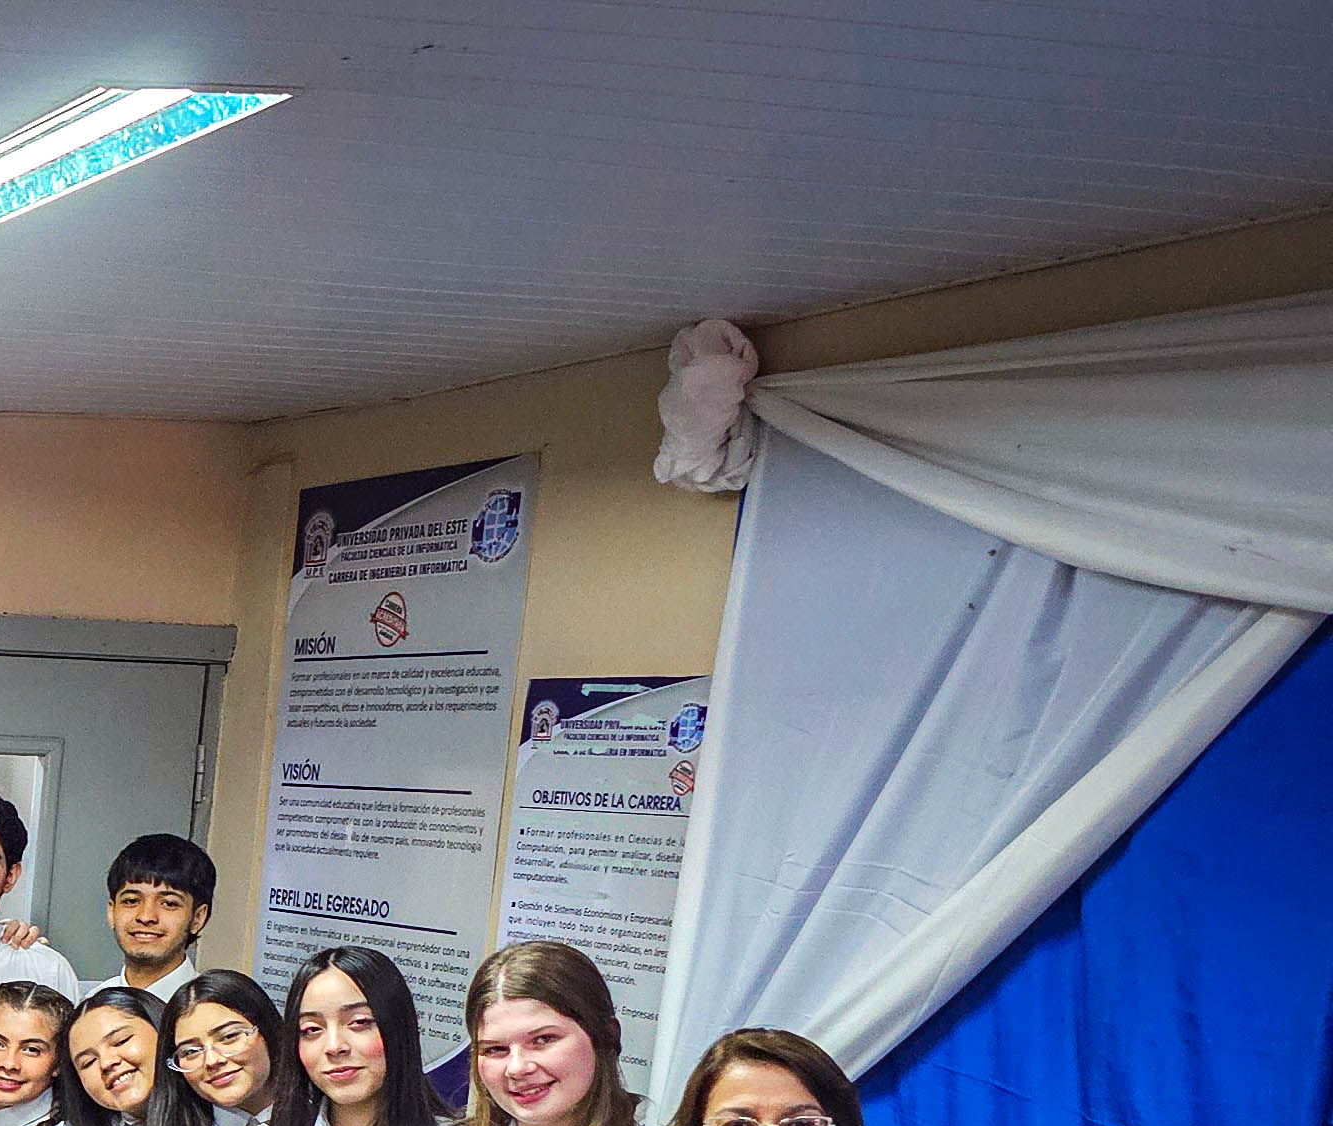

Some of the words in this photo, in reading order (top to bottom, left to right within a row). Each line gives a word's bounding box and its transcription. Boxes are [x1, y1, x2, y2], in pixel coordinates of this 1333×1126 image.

[336, 528, 388, 548] UNIVERSIDAD
[389, 524, 425, 542] PRIVADA
[427, 521, 444, 538] DEL
[445, 518, 468, 536] ESTE
[329, 570, 358, 584] CARRERA
[359, 569, 369, 581] DE
[408, 564, 418, 577] EN
[294, 632, 336, 655] MISIÓN
[401, 667, 424, 679] calidad
[485, 684, 500, 695] que
[282, 759, 320, 781] VISIÓN
[532, 789, 592, 806] OBJETIVOS
[594, 793, 608, 808] DE
[611, 793, 624, 809] LA
[627, 794, 682, 812] CARRERA
[526, 827, 555, 838] Formar
[557, 829, 612, 843] profesionales
[614, 835, 625, 843] en
[628, 833, 663, 847] Ciencias
[666, 836, 677, 847] de
[568, 845, 586, 856] para
[651, 868, 680, 880] sistema
[269, 887, 301, 908] PERFIL
[304, 891, 324, 911] DEL
[326, 894, 390, 919] EGRESADO
[508, 915, 522, 925] que
[525, 915, 556, 929] incluyen
[559, 919, 576, 931] todo
[597, 925, 607, 935] de
[544, 904, 553, 913] de
[629, 912, 673, 928] Empresariale
[397, 940, 441, 955] emprendedor
[442, 946, 455, 956] con
[456, 948, 470, 959] una
[431, 961, 469, 976] problemas
